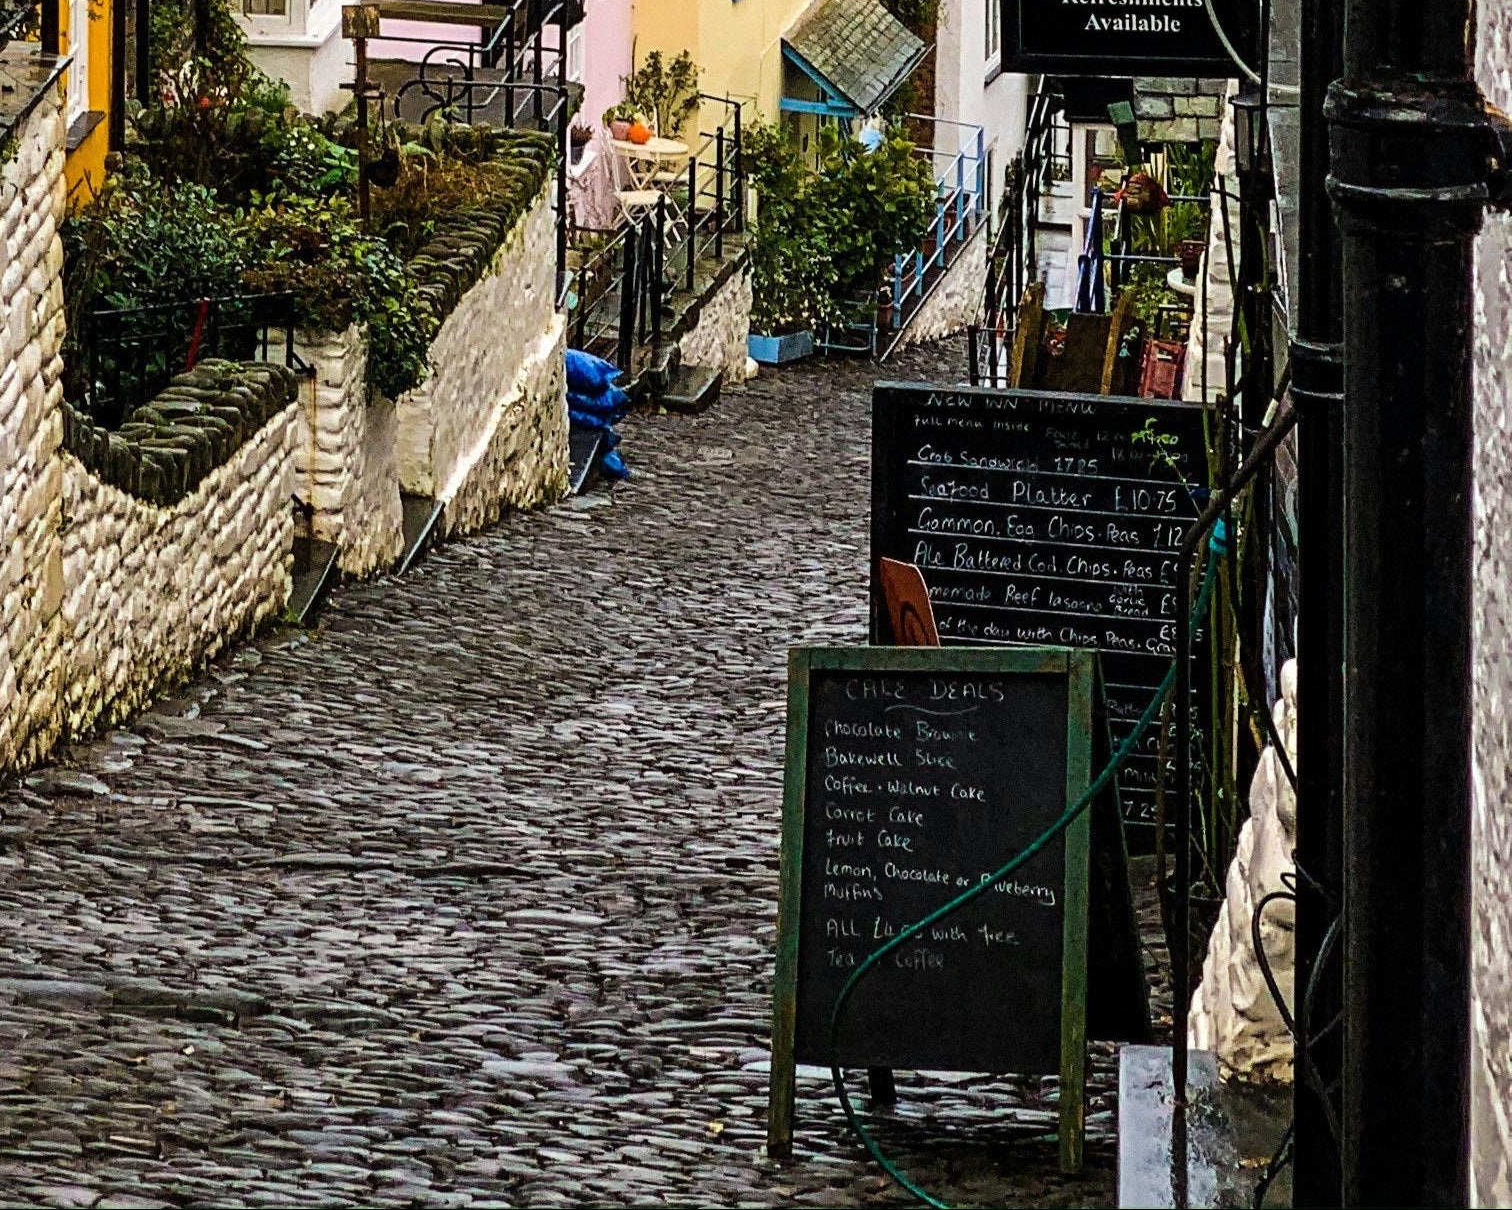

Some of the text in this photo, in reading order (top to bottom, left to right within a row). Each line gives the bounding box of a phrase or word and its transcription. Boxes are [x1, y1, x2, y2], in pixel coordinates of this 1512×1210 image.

[1085, 13, 1181, 33] Available
[924, 393, 973, 407] NEW
[917, 443, 953, 462] Crab
[921, 475, 989, 502] Seafood
[1013, 479, 1093, 507] Platter
[1106, 522, 1140, 544] Peas
[914, 540, 945, 567] Ale
[953, 542, 1022, 570] Battered
[1122, 559, 1153, 580] Peas
[1005, 583, 1041, 607] Beef
[1016, 625, 1053, 641] with
[928, 679, 1005, 703] DEALS
[825, 745, 958, 771] Bakewell Slice
[824, 774, 987, 803] Coffee Walnut Cake
[825, 801, 925, 826] Carrot Cake
[877, 828, 914, 853] Cake
[884, 861, 950, 886] Chocolate
[956, 875, 971, 887] or
[824, 881, 885, 902] Muffins
[931, 924, 969, 942] with
[827, 948, 856, 968] Tea
